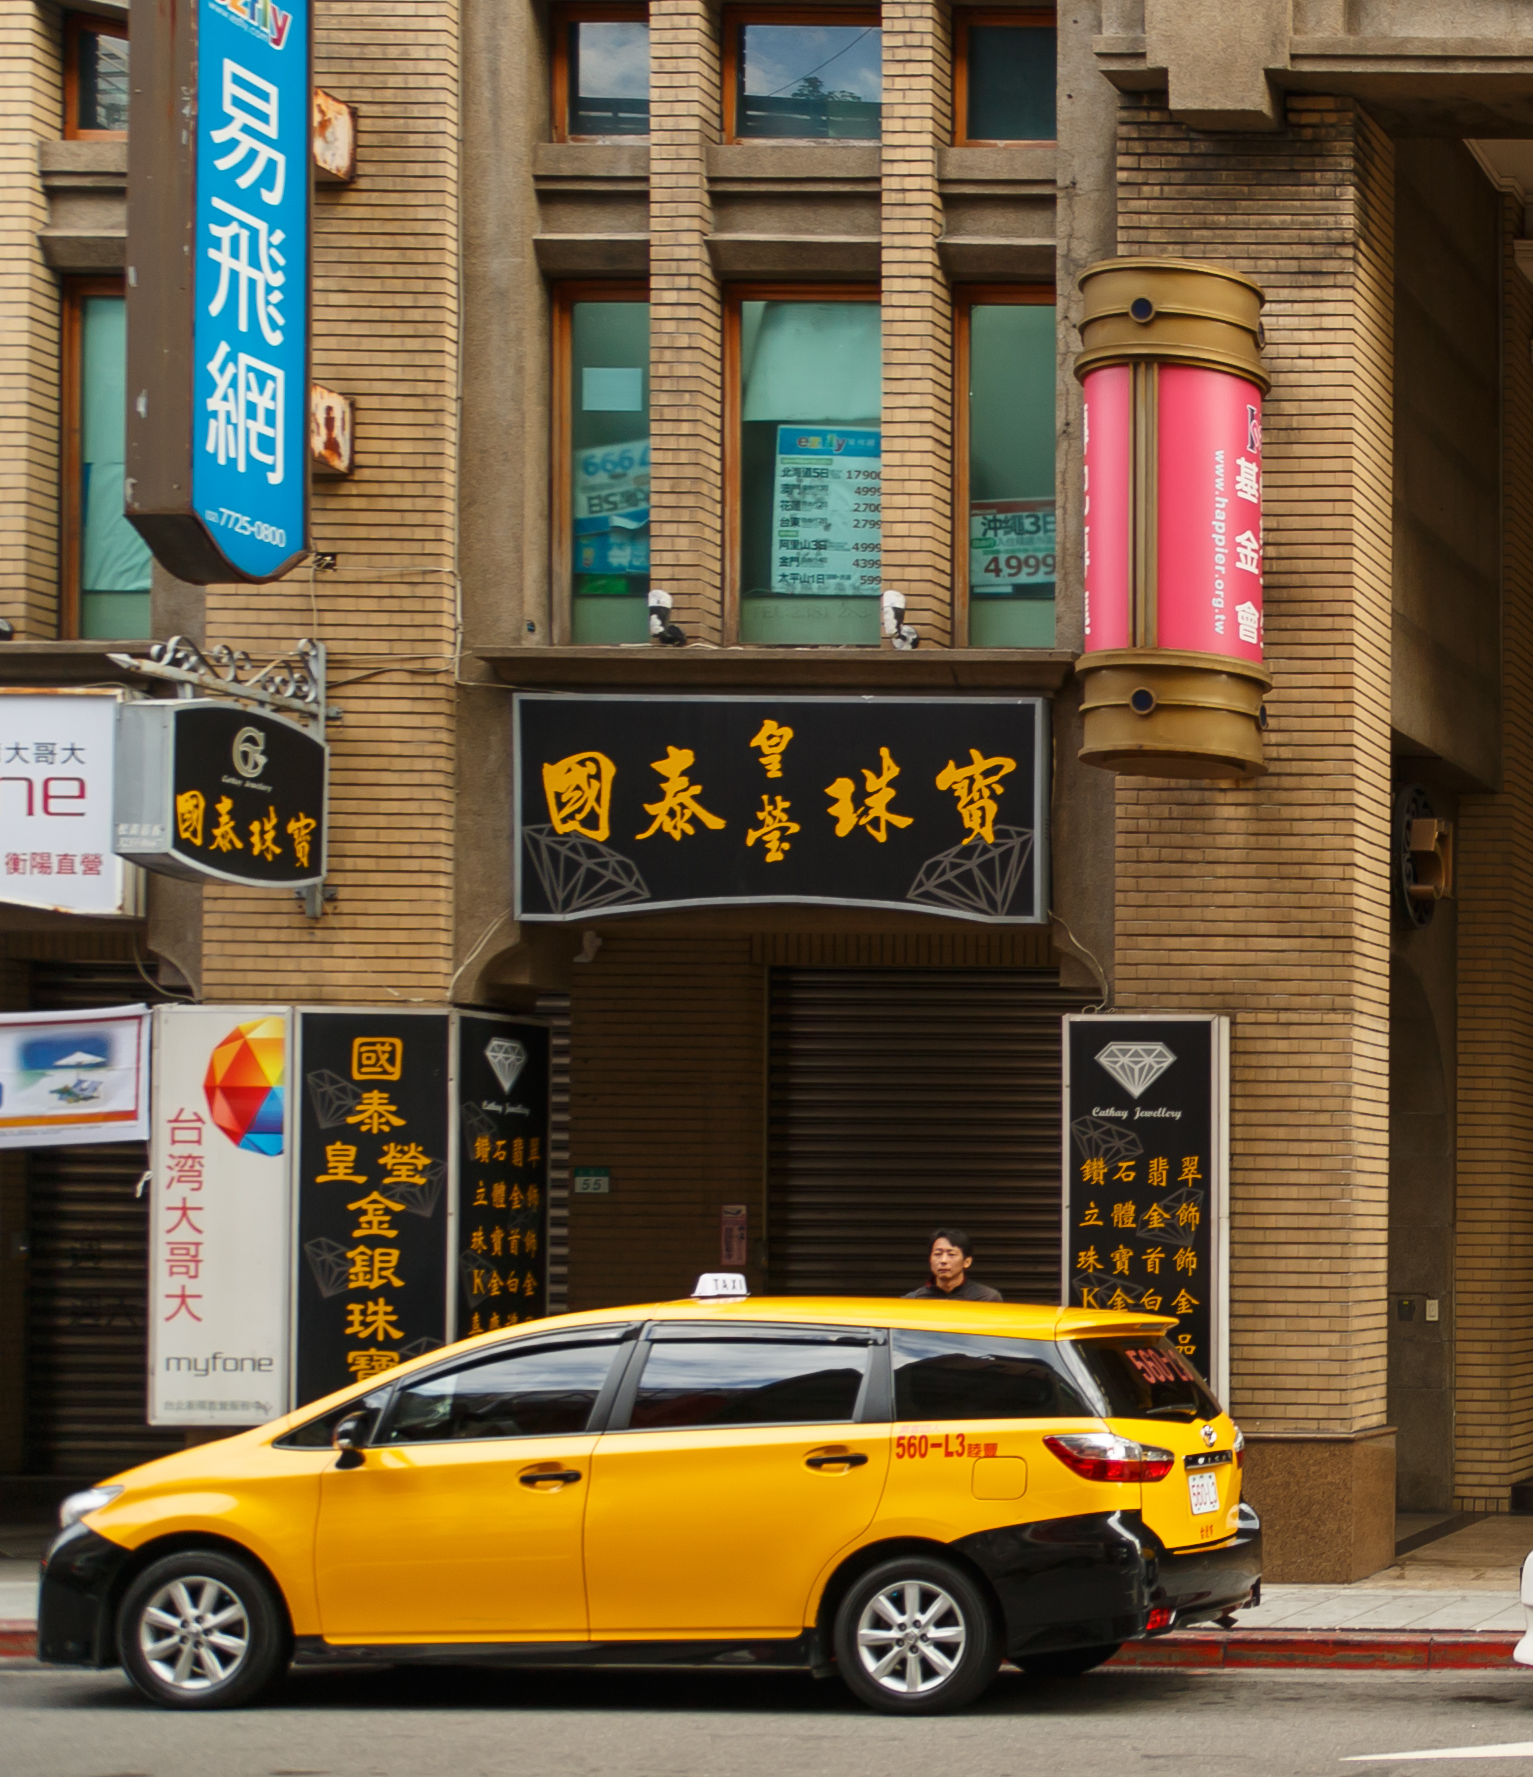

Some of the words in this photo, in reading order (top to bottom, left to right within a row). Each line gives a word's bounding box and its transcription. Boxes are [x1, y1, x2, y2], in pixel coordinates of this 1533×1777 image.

[206, 57, 286, 486] 易飛網
[1211, 449, 1229, 635] www.happier.org.tw
[0, 742, 87, 765] 大哥大
[175, 790, 317, 868] 國泰珠寶
[1092, 1106, 1128, 1119] Cathay
[1134, 1106, 1182, 1120] Jewellery
[580, 1177, 602, 1192] 55
[1079, 1155, 1203, 1188] 鑽石翡翠
[1079, 1200, 1201, 1232] 立體金飾
[1076, 1243, 1199, 1277] 珠寶首飾
[713, 1278, 744, 1291] TAXI
[1080, 1287, 1200, 1315] K金白金
[165, 1351, 274, 1377] myfone
[895, 1432, 966, 1460] 560-L3
